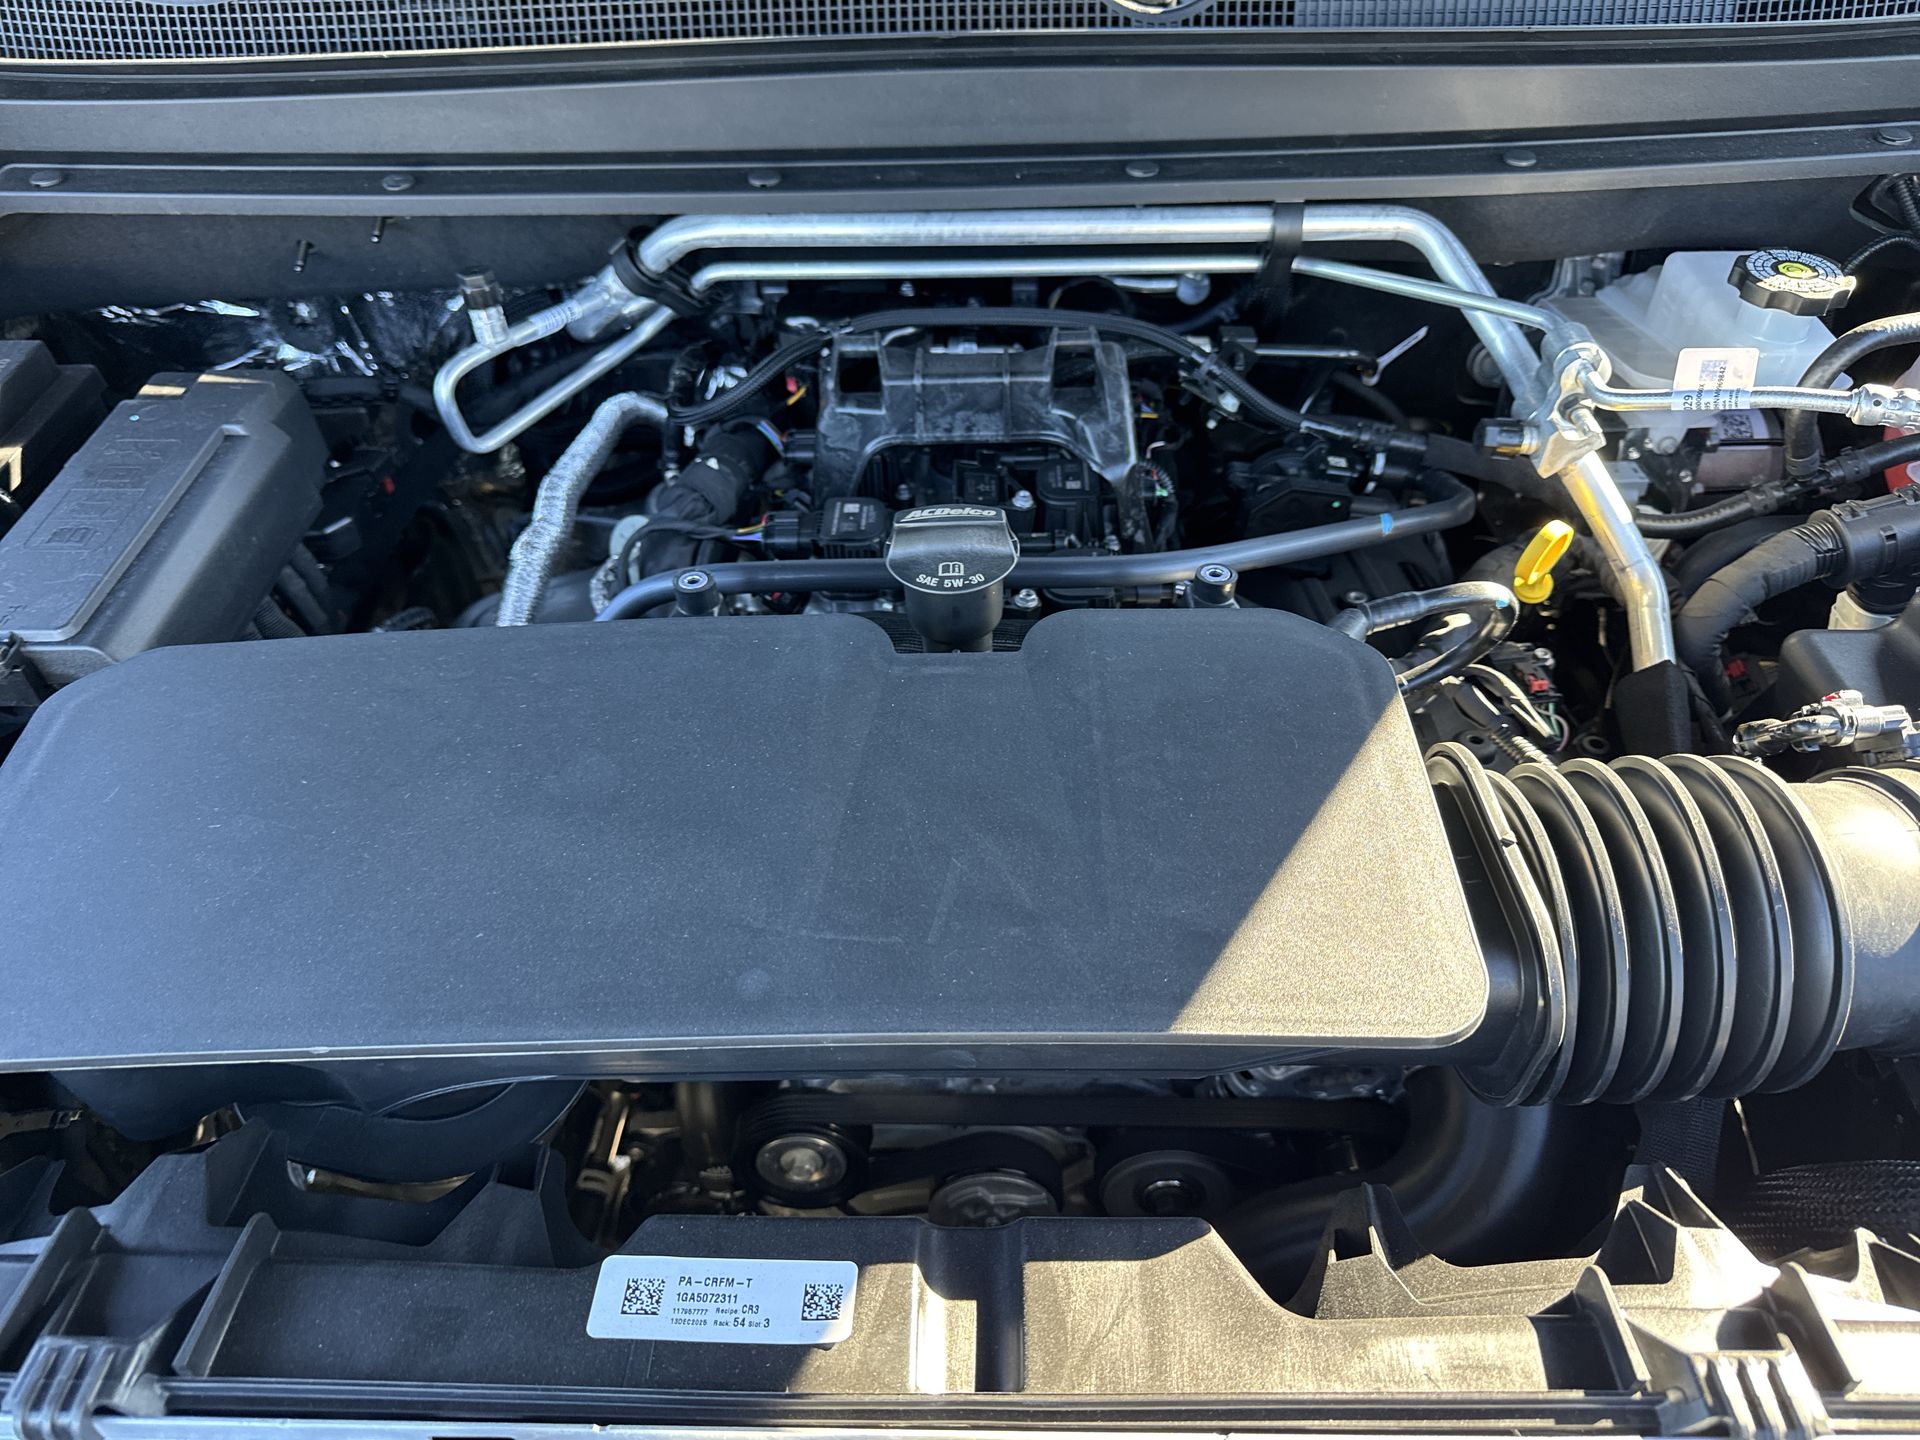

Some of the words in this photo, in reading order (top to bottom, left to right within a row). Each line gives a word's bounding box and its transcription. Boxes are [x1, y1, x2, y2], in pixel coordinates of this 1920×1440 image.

[903, 507, 997, 519] ACDelco
[916, 573, 939, 587] SAE
[943, 573, 985, 588] 5W-30
[676, 1292, 738, 1304] 1GA5072311
[741, 1304, 760, 1315] CR3
[733, 1316, 746, 1327] 54
[763, 1317, 771, 1328] 3
